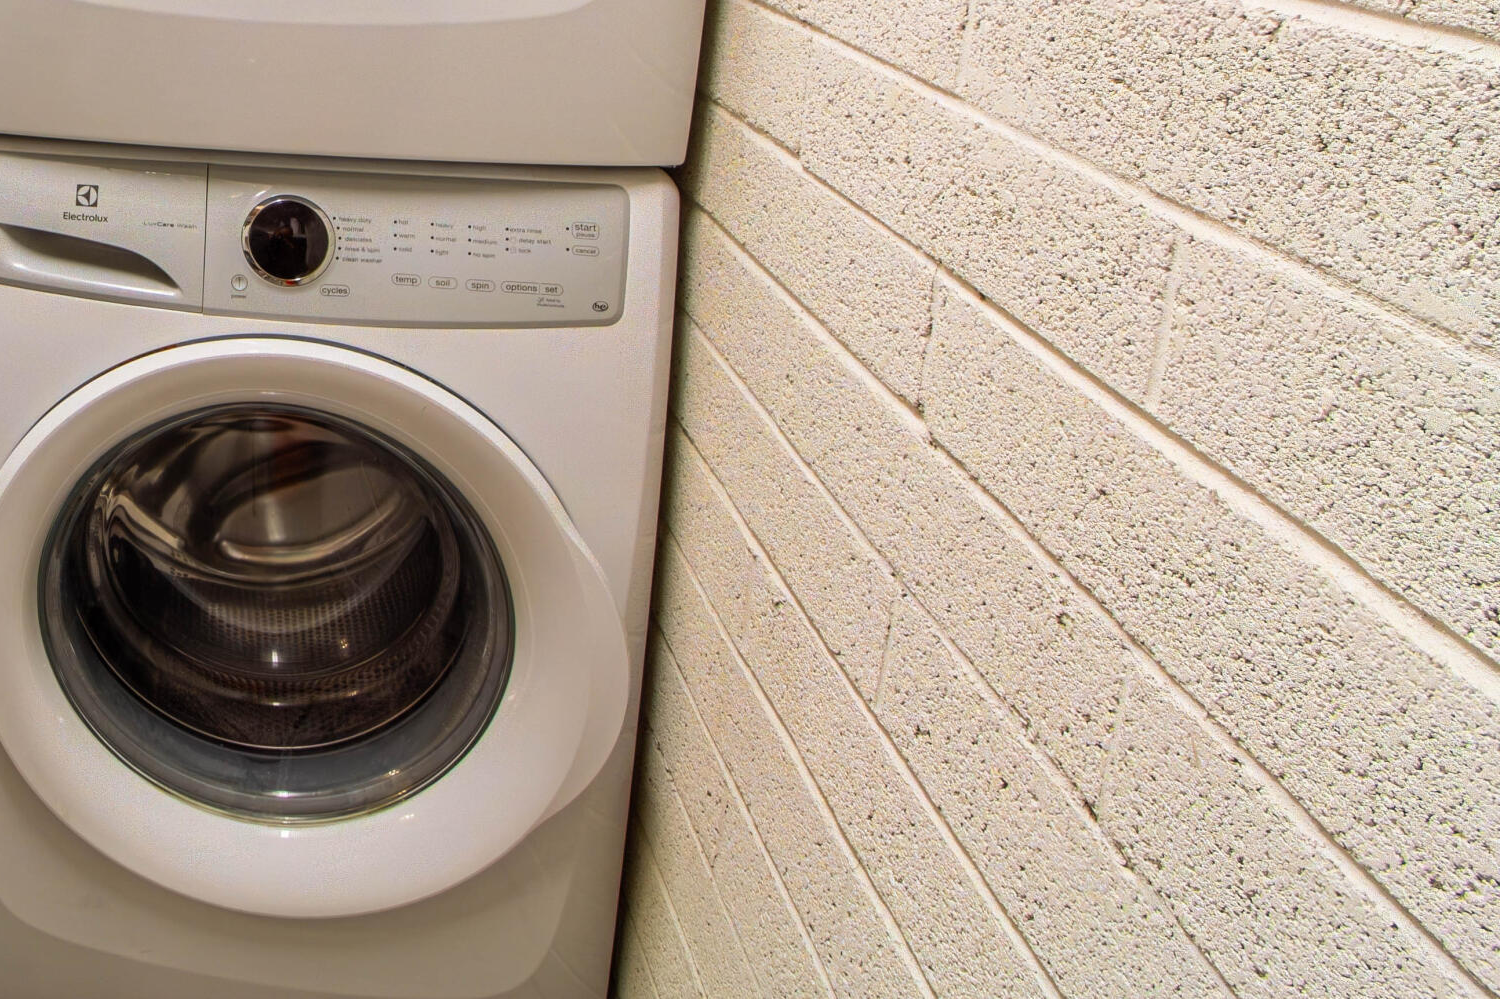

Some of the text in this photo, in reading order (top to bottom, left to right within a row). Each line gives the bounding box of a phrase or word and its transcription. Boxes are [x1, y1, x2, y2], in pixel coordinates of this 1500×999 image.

[62, 212, 108, 223] Electrolux
[575, 224, 597, 232] start
[395, 276, 418, 286] temp
[471, 282, 490, 291] spin
[506, 283, 558, 294] options set
[322, 287, 348, 296] cycles
